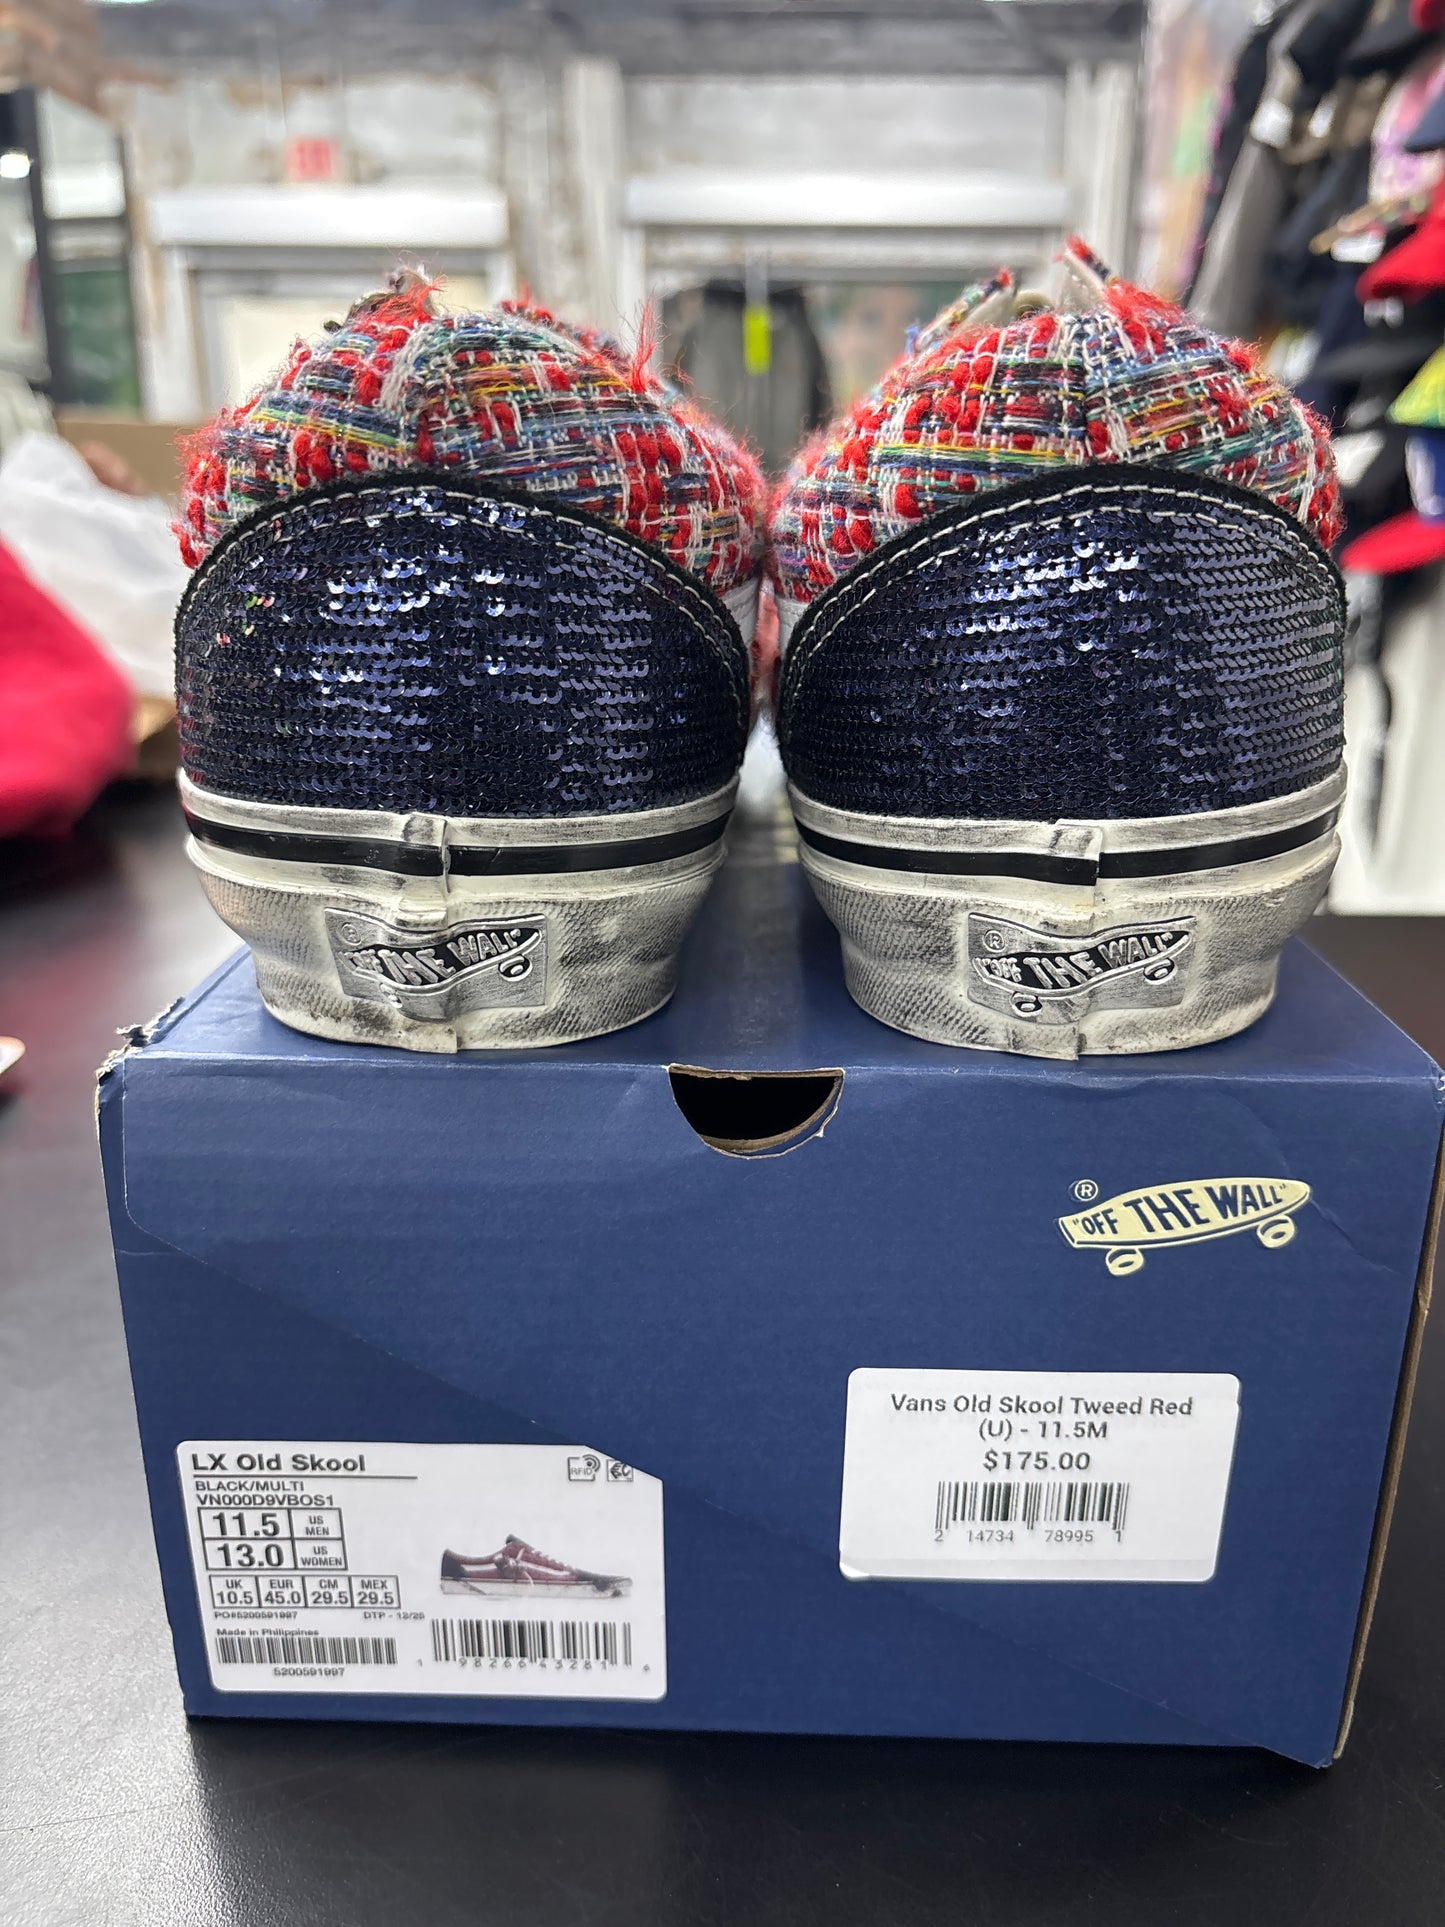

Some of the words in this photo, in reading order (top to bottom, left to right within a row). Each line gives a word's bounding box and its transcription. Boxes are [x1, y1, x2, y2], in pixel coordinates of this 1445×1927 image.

[378, 948, 457, 986] THE
[1023, 951, 1104, 989] THE
[1123, 1188, 1210, 1233] THE
[891, 1394, 946, 1413] Vans
[953, 1394, 991, 1414] Old
[998, 1395, 1063, 1415] Skool
[1070, 1396, 1142, 1416] Tweed
[1149, 1396, 1193, 1416] Red
[978, 1420, 1012, 1441] (U)
[1038, 1420, 1108, 1439] 11.5M
[192, 1453, 228, 1471] LX
[236, 1453, 282, 1471] Old
[291, 1453, 366, 1472] Skool
[983, 1449, 1091, 1472] $175.00
[195, 1481, 304, 1492] BLACK/MULTI
[212, 1511, 281, 1537] 11.5
[308, 1516, 324, 1525] US
[305, 1526, 330, 1536] MEN
[934, 1530, 944, 1542] 2
[967, 1529, 1015, 1543] 14734
[1044, 1530, 1094, 1543] 78995
[1114, 1530, 1122, 1543] 1
[217, 1543, 284, 1567] 13.0
[312, 1546, 328, 1555] US
[301, 1557, 343, 1567] WOMEN
[226, 1579, 243, 1589] UK
[269, 1579, 294, 1589] EUR
[319, 1579, 339, 1589] CM
[361, 1579, 388, 1590] MEX
[216, 1591, 254, 1604] 10.5
[264, 1591, 301, 1604] 45.0
[311, 1591, 349, 1605] 29.5
[357, 1591, 395, 1605] 29.5
[216, 1628, 246, 1636] Made
[261, 1629, 319, 1638] Philippines
